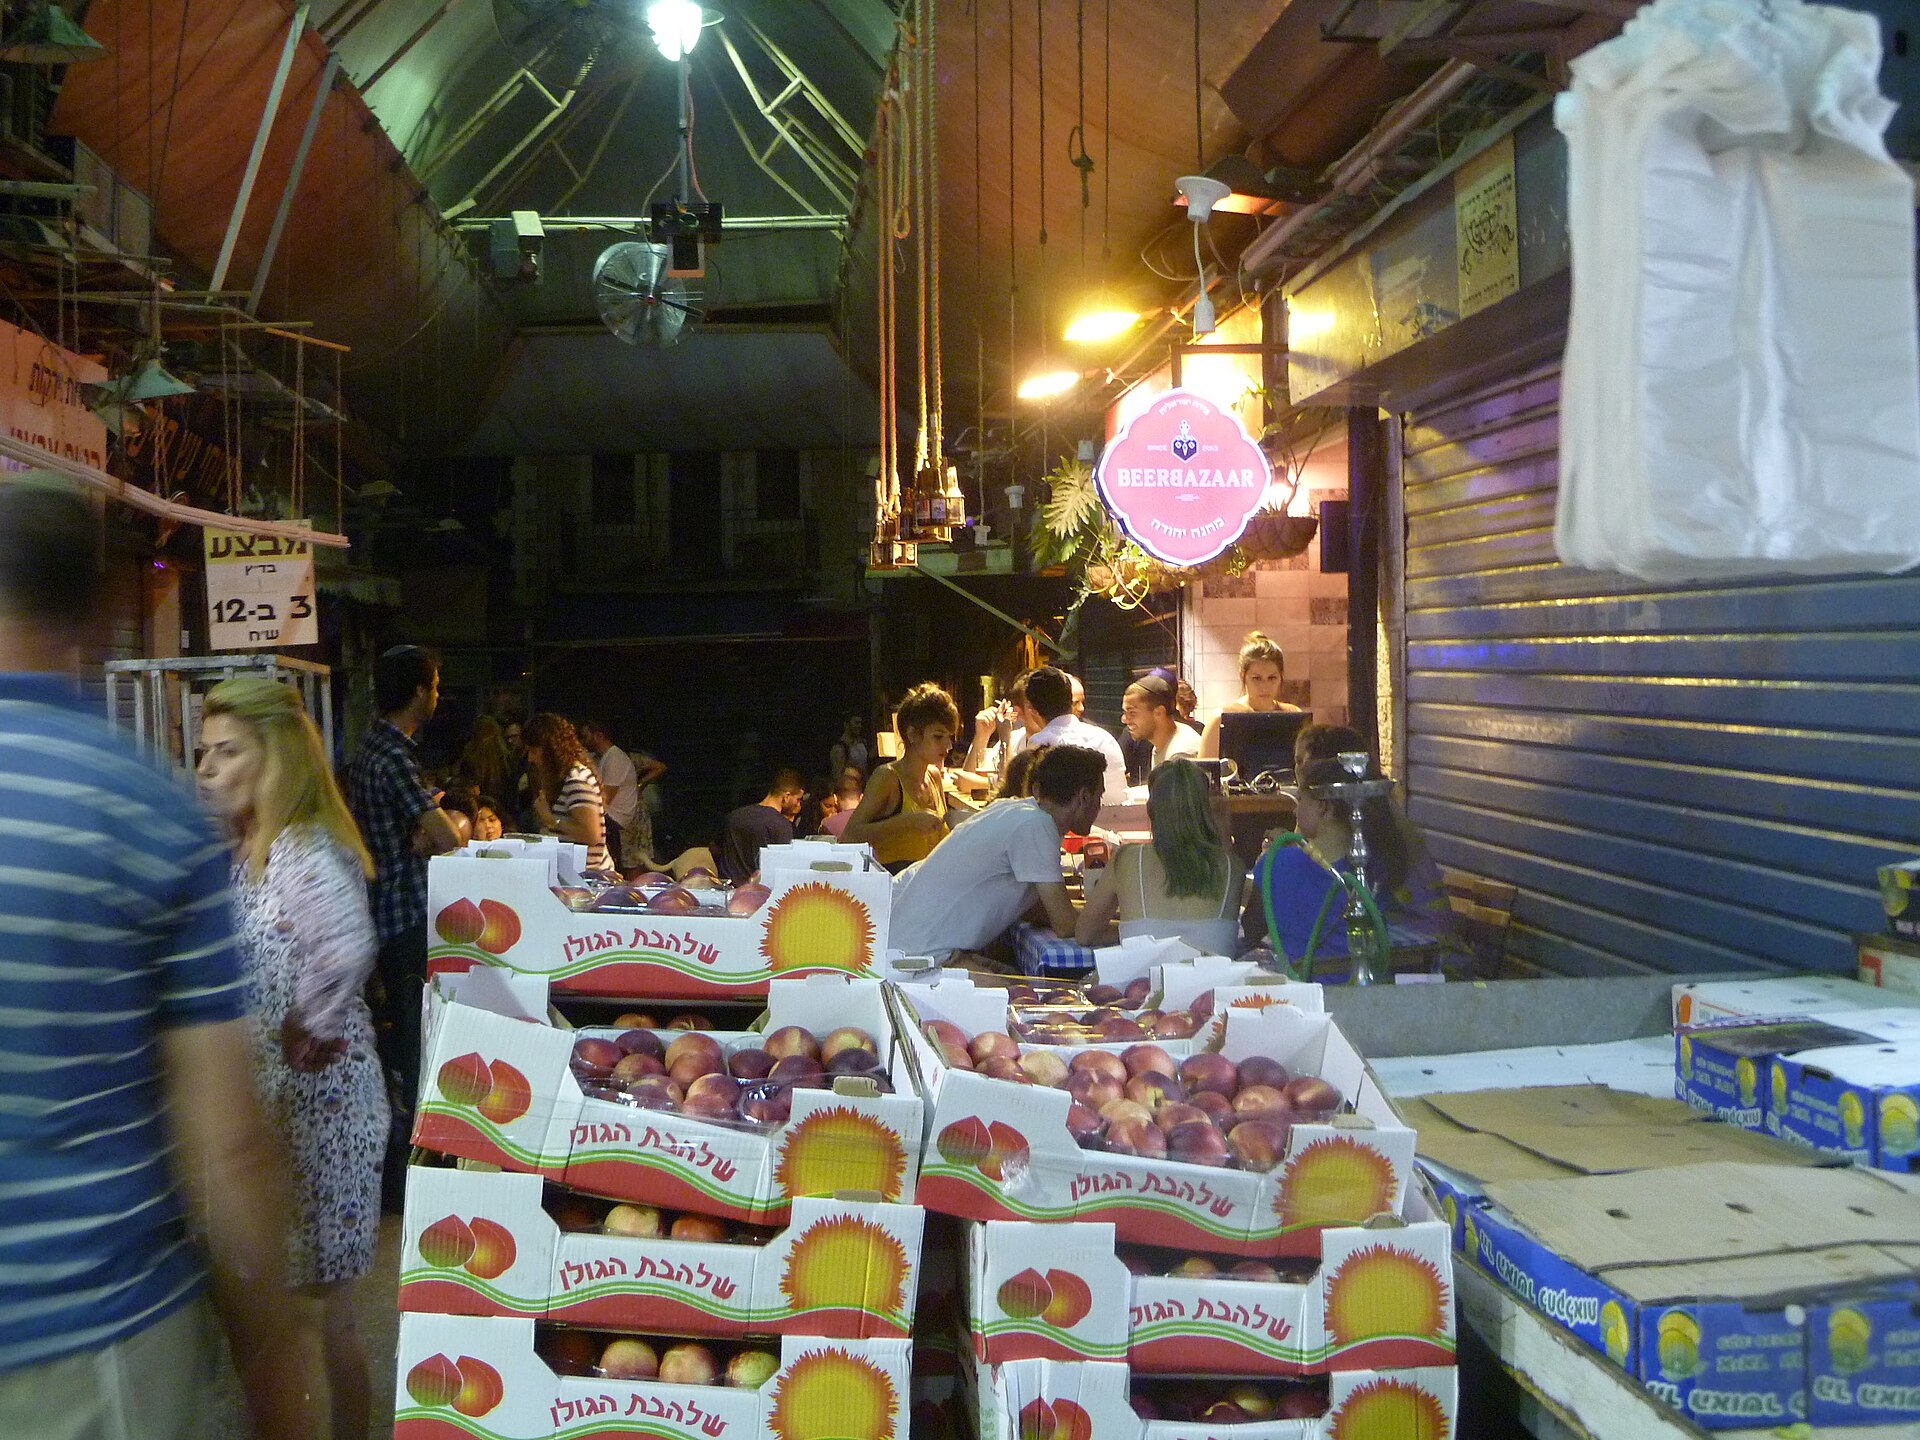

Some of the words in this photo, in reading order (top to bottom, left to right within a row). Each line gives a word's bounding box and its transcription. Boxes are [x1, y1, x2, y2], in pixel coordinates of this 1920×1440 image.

[1150, 517, 1187, 539] יהודה
[1190, 517, 1225, 539] מחנה
[210, 534, 307, 558] מבצע
[290, 595, 312, 619] 3
[563, 928, 623, 963] הגולן
[633, 928, 721, 965] שלהבת
[1138, 1171, 1235, 1217] שלהבת
[559, 1257, 627, 1291] הגולן
[634, 1256, 737, 1301] שלהבת
[1192, 1297, 1292, 1341] שלהבת
[550, 1395, 618, 1429] הגולן
[625, 1393, 728, 1438] שלהבת
